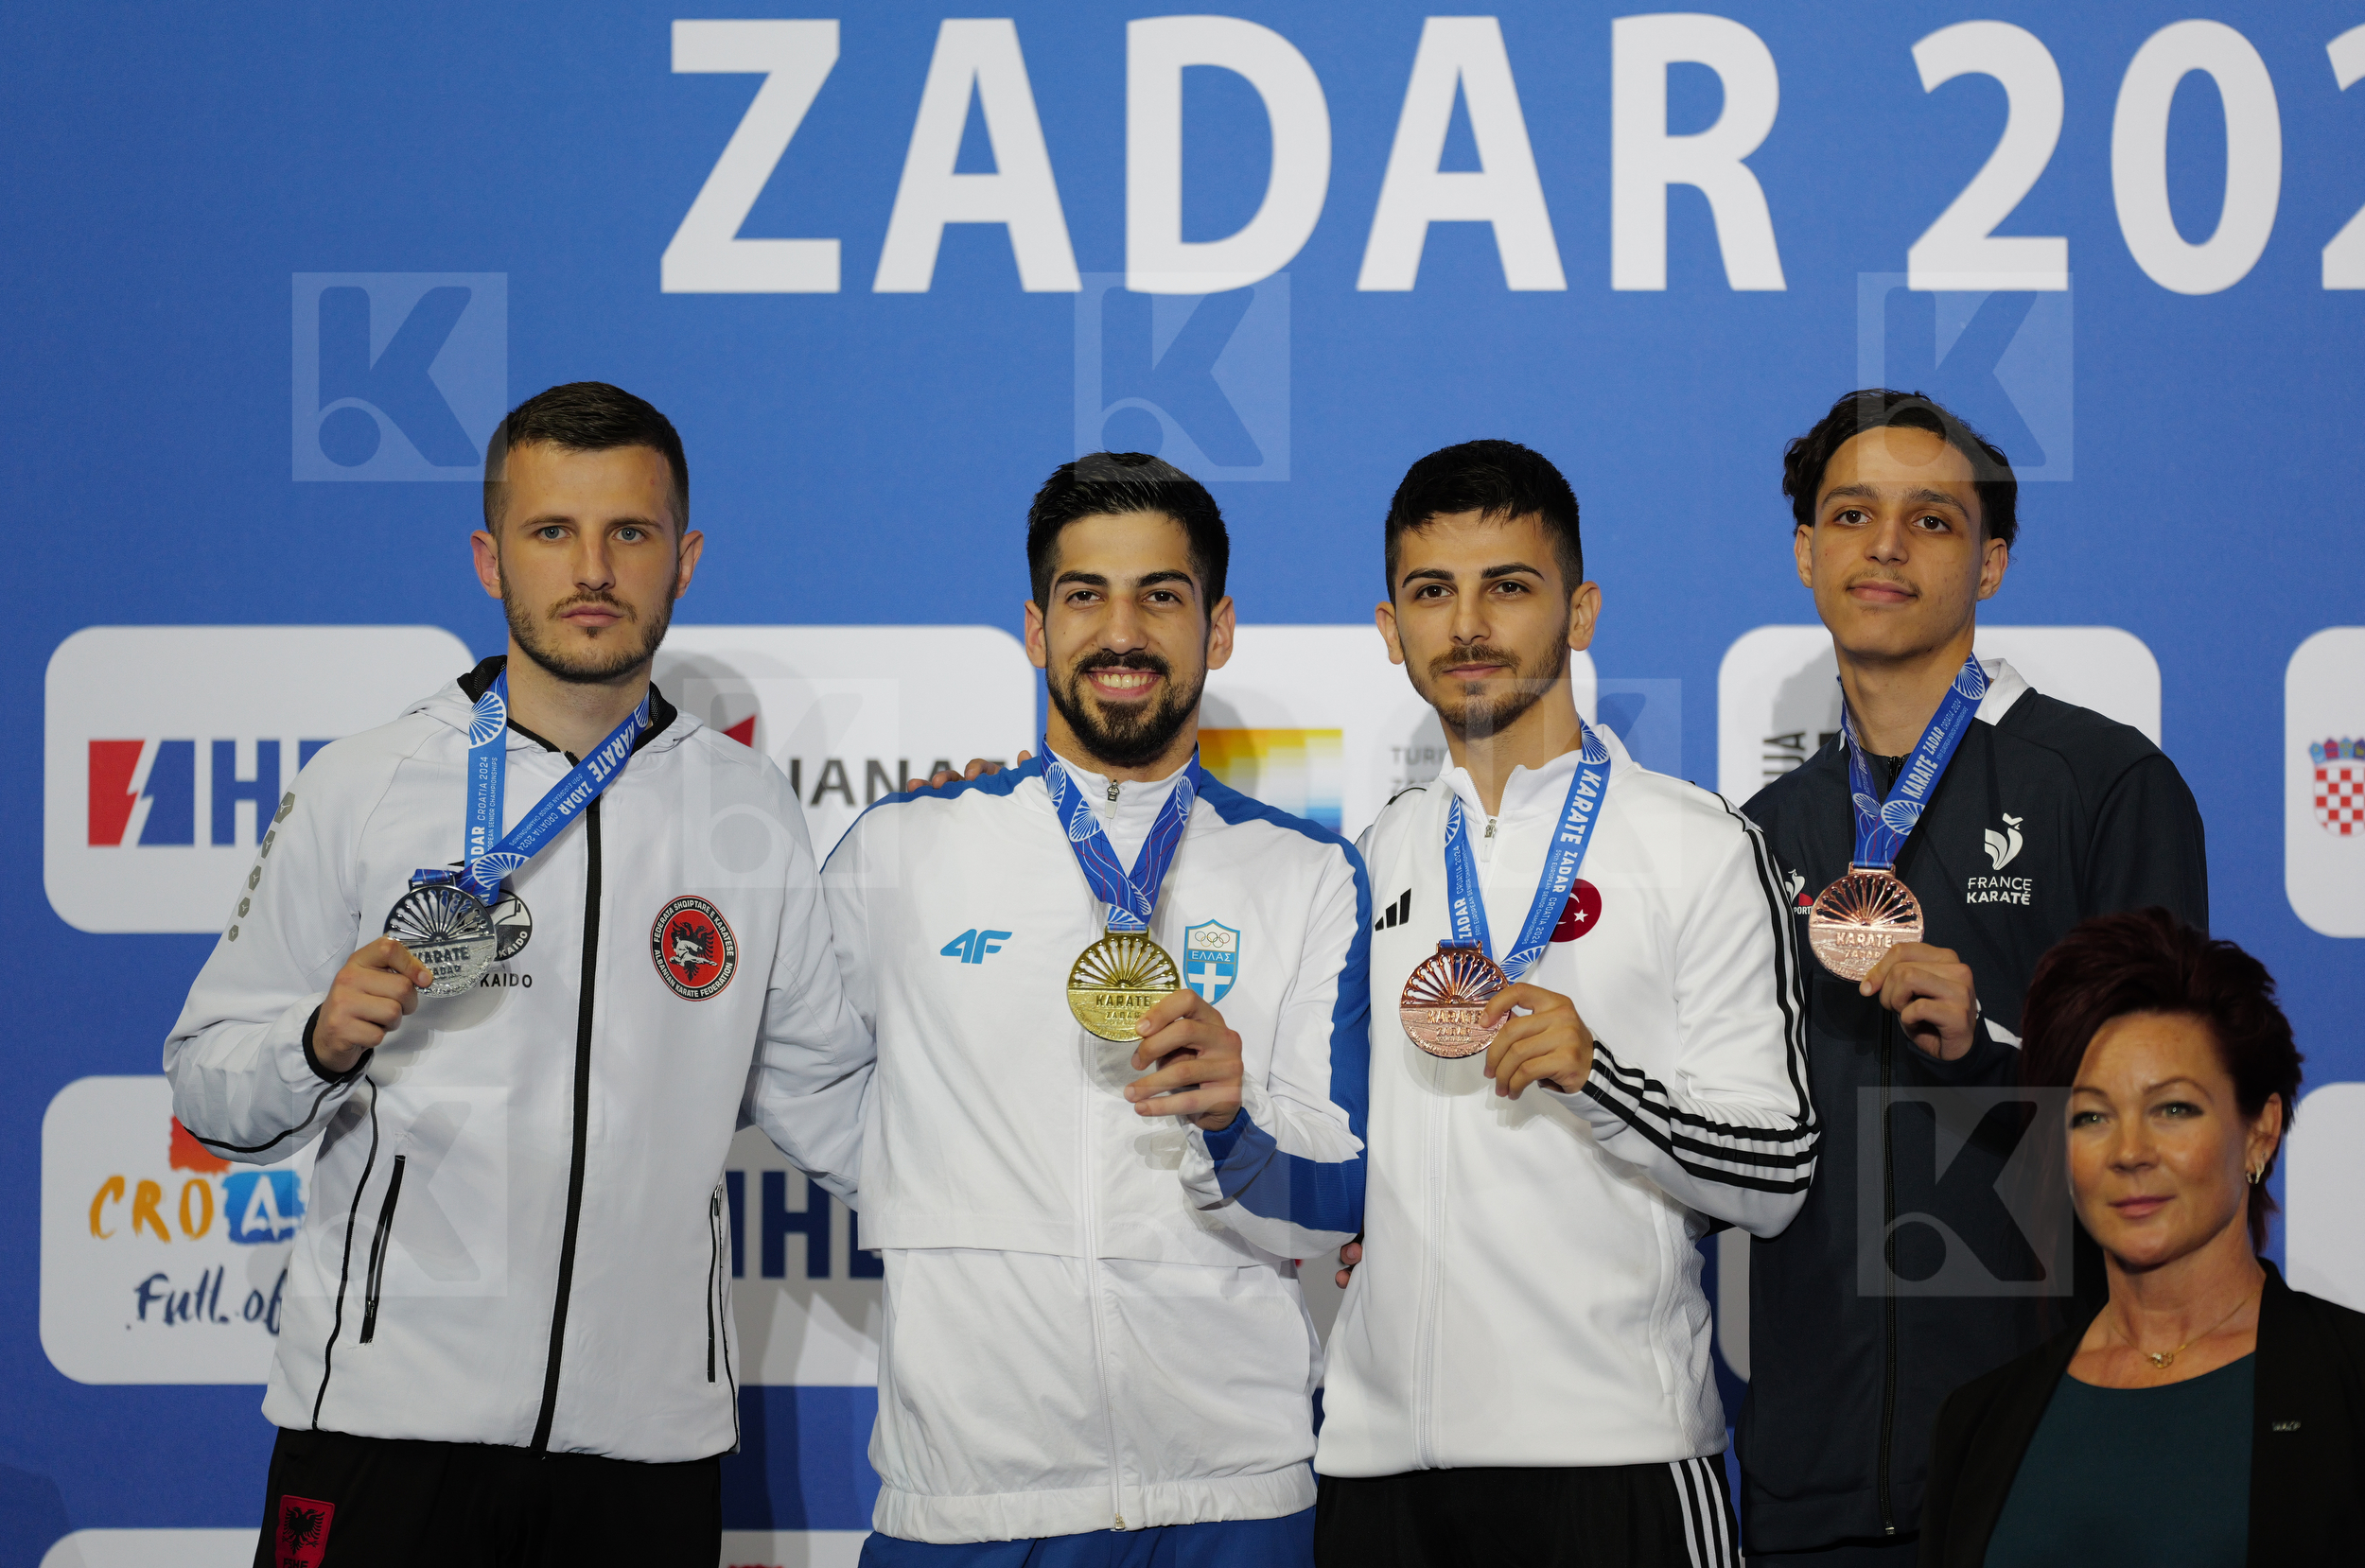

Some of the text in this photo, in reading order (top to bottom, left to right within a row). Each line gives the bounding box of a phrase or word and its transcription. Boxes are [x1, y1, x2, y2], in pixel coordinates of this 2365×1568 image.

[660, 12, 2365, 295] ZADAR 20
[480, 756, 489, 780] 2024
[1901, 754, 1938, 800] KARATE
[1922, 726, 1946, 756] ZADAR
[489, 757, 499, 804] CHAMPIONSHIPS
[517, 721, 635, 851] KARATE ZADAR CROATIA 2024
[477, 783, 488, 821] CROATIA
[1531, 768, 1603, 944] KARATE ZADAR CROATIA 2024
[1456, 864, 1464, 895] CROATIA
[1968, 876, 2033, 891] FRANCE
[1967, 890, 2031, 906] KARATÉ
[654, 899, 734, 956] FEDERATA SHQIPTARE E KARATESE
[1454, 897, 1472, 939] ZADAR
[498, 931, 529, 958] KAIDO
[939, 929, 1013, 965] 4F
[1191, 950, 1232, 963] ΕΛΛΑΣ
[1835, 932, 1893, 949] KARATE
[431, 965, 462, 976] ADAR
[480, 973, 533, 988] KAIDO
[654, 950, 733, 998] ALBANIAN KARATE FEDERATION
[1095, 994, 1152, 1008] KARATE
